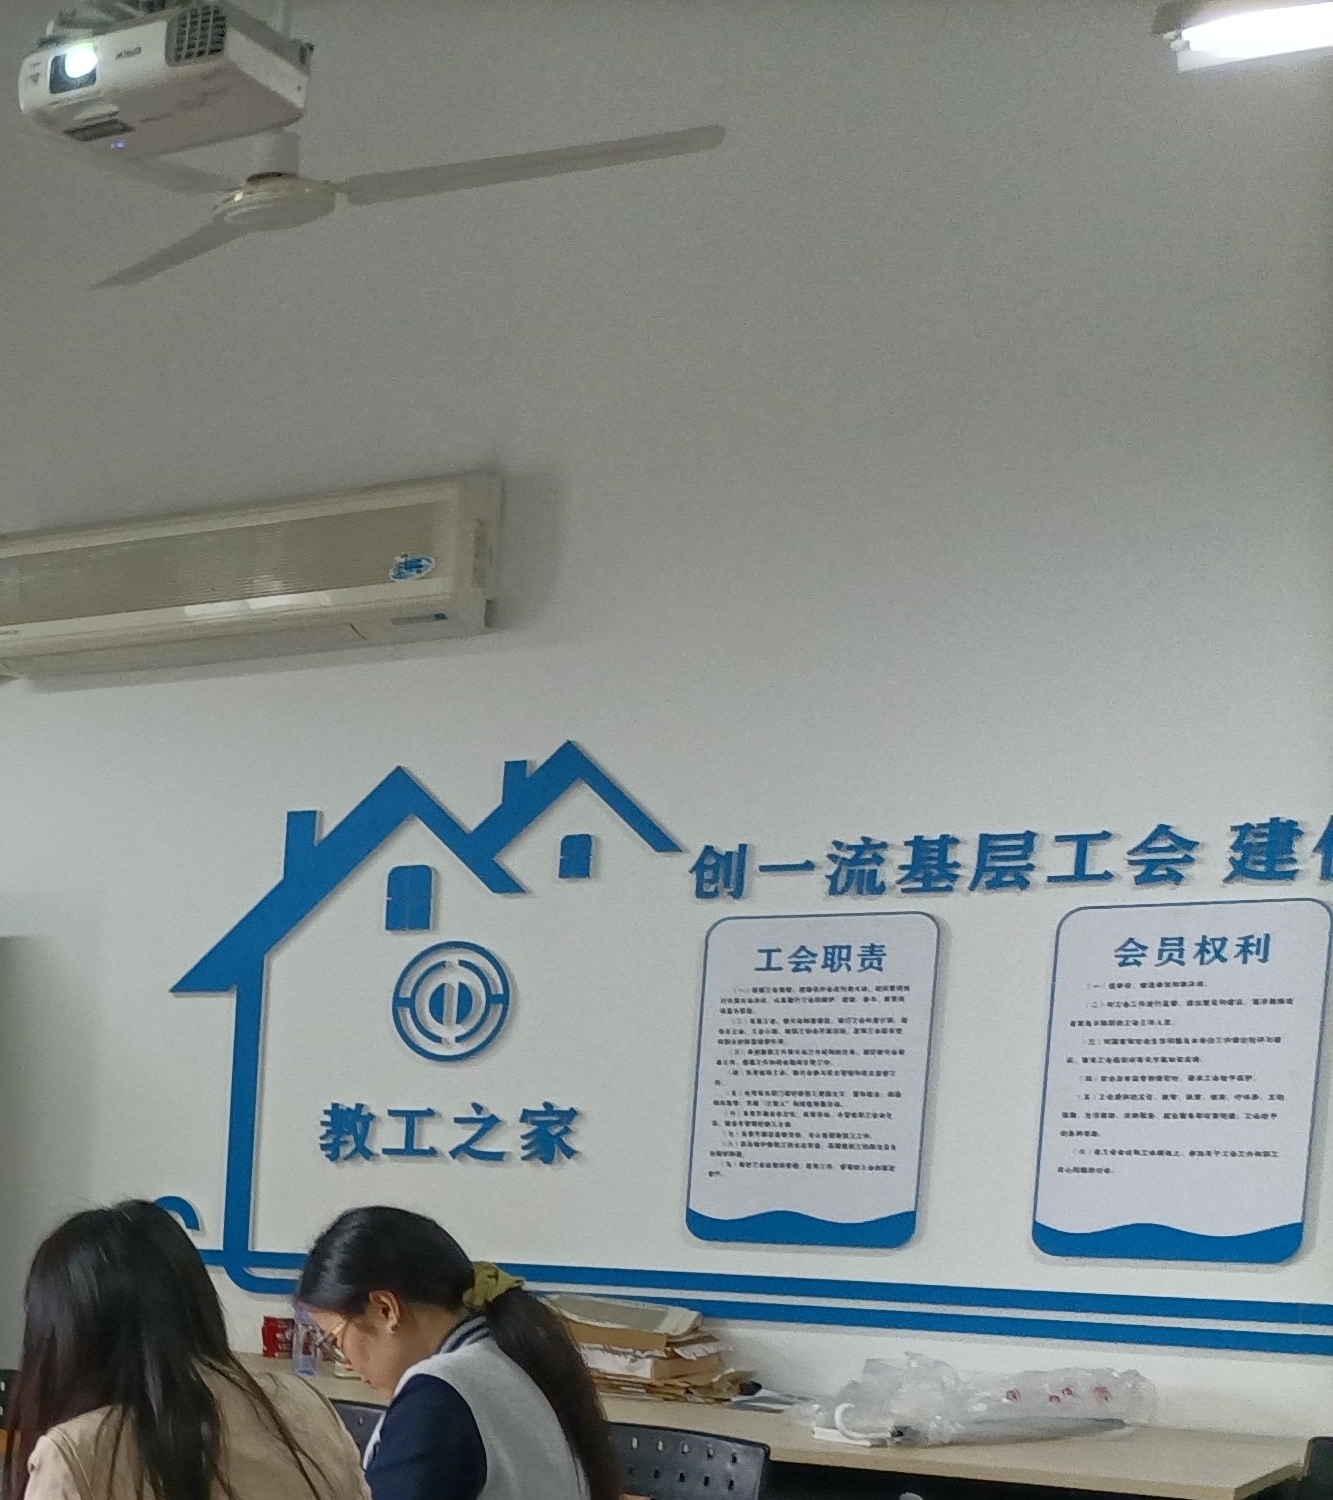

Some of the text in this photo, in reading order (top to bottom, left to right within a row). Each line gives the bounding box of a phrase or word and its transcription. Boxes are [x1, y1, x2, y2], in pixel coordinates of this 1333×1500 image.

[688, 815, 1333, 899] 创一流基层工会 建
[754, 943, 888, 974] 工会职责
[1113, 933, 1272, 968] 会员权利
[318, 1101, 581, 1165] 教工之家
